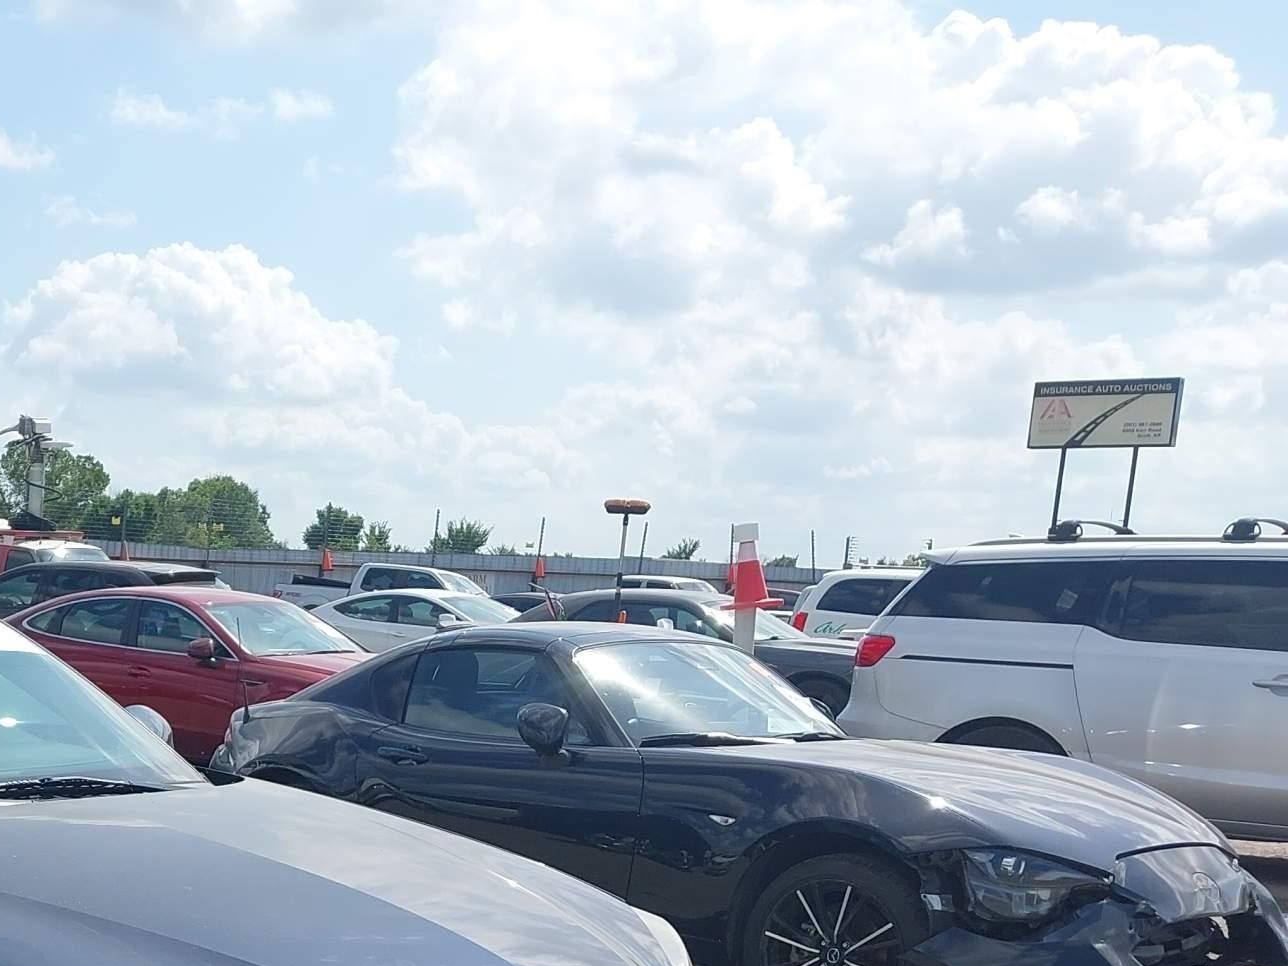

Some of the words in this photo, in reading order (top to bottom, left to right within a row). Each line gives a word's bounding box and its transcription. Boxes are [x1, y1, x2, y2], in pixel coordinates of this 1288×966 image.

[1040, 385, 1094, 395] INSURANCE
[1095, 384, 1121, 394] AUTO
[1123, 383, 1172, 392] AUCTIONS
